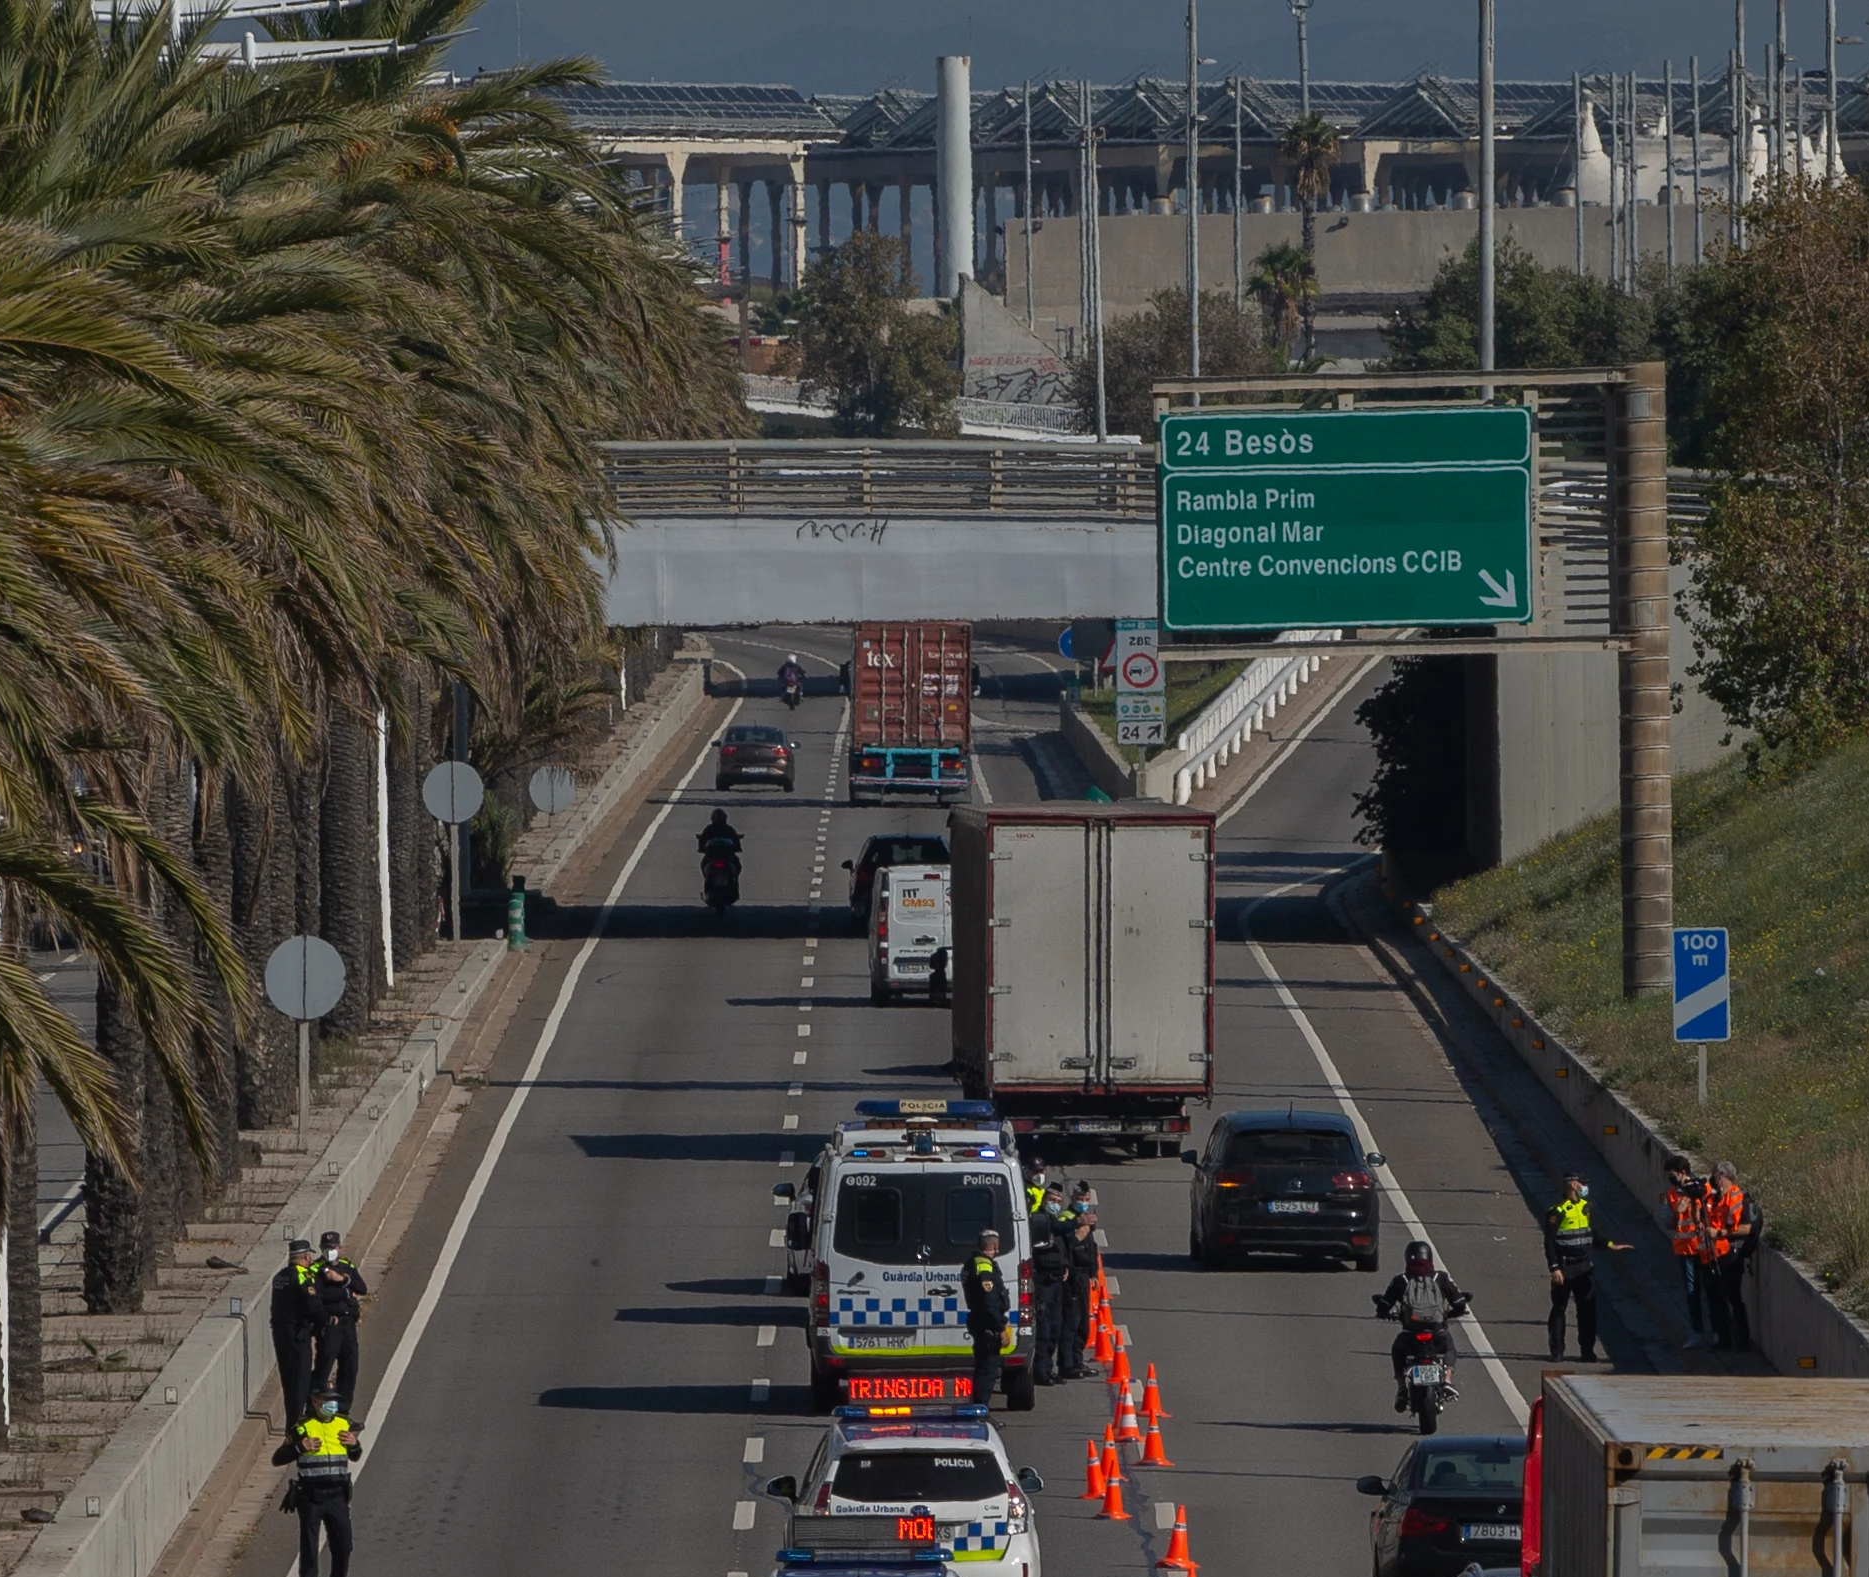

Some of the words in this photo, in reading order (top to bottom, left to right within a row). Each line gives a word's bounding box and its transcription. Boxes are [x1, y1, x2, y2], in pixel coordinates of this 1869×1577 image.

[1176, 431, 1210, 457] 24
[1226, 427, 1314, 457] Besòs
[1176, 488, 1257, 512] Rambla
[1265, 487, 1316, 509] Prim
[1177, 522, 1276, 549] Diagonal
[1284, 522, 1325, 543] Mar
[1178, 555, 1251, 579] Centre
[1257, 552, 1397, 576] Convencions
[1403, 549, 1463, 573] CCIB
[1129, 636, 1152, 646] ZBE
[866, 649, 895, 668] tex
[1121, 726, 1140, 740] 24
[1681, 933, 1719, 952] 100
[1691, 953, 1709, 967] m
[856, 1176, 877, 1187] 092
[882, 1271, 923, 1283] Guàrdia
[925, 1271, 962, 1283] Urbana
[856, 1336, 881, 1350] 5761
[934, 1457, 976, 1469] POLICIA
[836, 1504, 871, 1514] Guàrdia
[874, 1504, 906, 1514] Urbana
[1473, 1524, 1506, 1537] 7803
